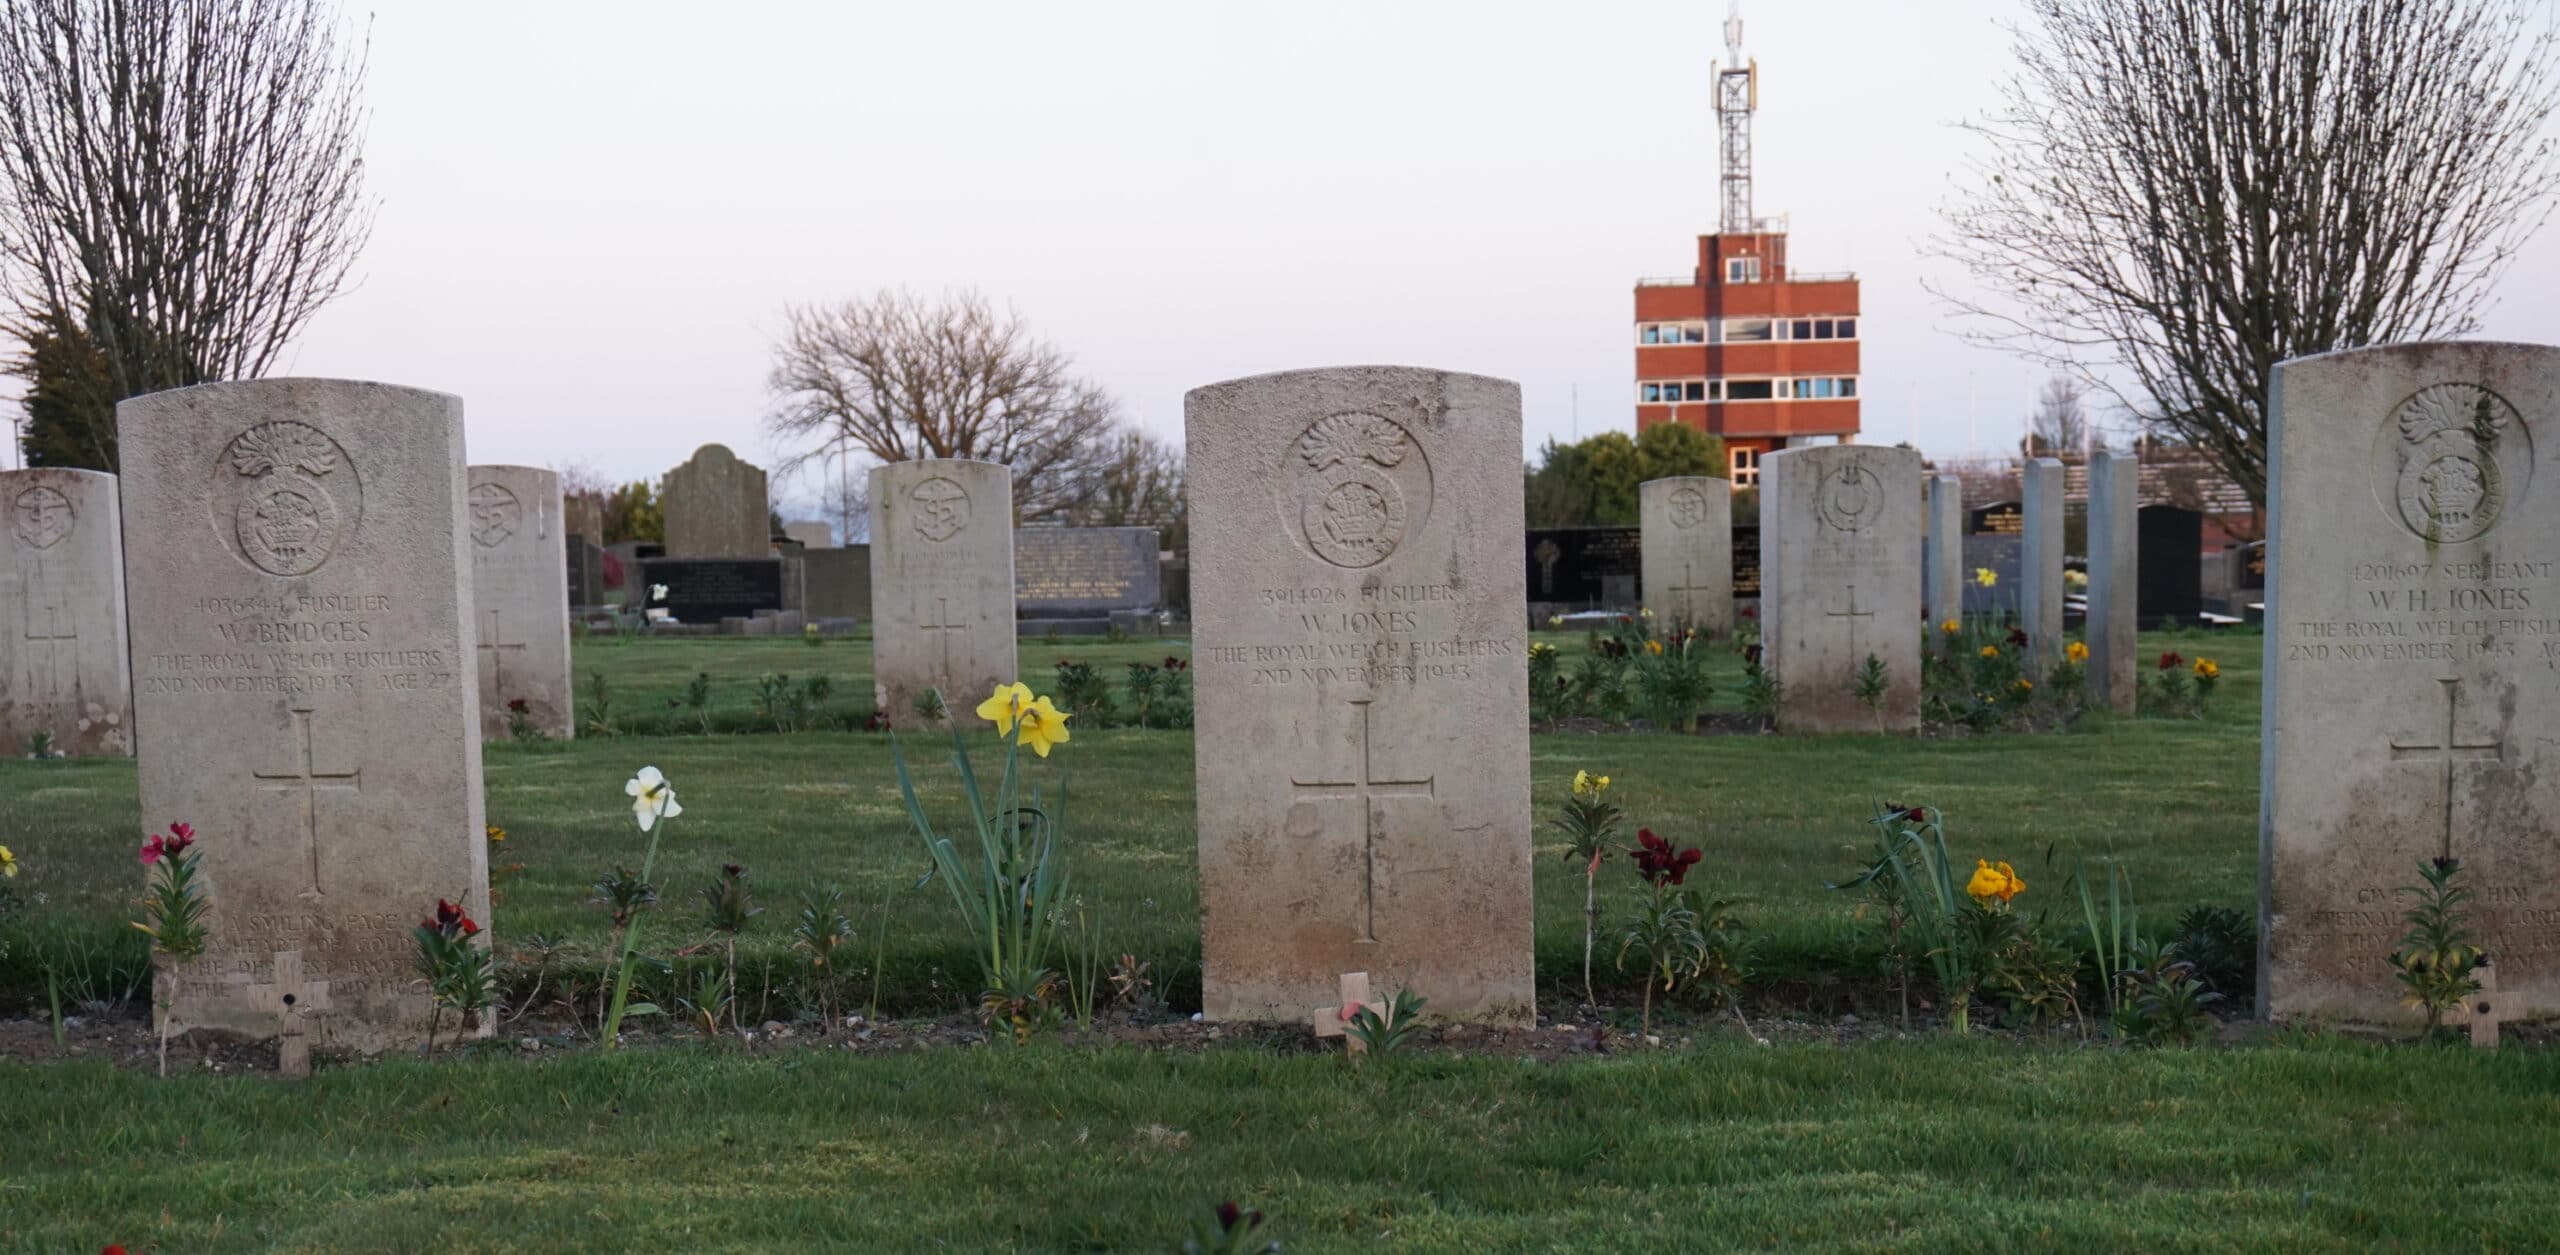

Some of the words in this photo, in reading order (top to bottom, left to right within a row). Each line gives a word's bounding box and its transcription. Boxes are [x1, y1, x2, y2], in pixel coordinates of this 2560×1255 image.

[297, 594, 391, 612] FUSILIER
[1261, 587, 1347, 606] 3914926
[1360, 584, 1456, 602] FUSILIER
[2446, 587, 2531, 612] JONES
[257, 621, 370, 643] BRIDGES
[1335, 610, 1417, 634] JONES
[2298, 621, 2338, 638] THE
[2345, 621, 2408, 638] ROYAL
[2417, 619, 2488, 637] WELCH
[2496, 618, 2560, 636] FUSILI
[152, 654, 192, 671] THE
[200, 652, 261, 671] ROYAL
[266, 651, 335, 670] WELCH
[343, 649, 441, 668] FUSILIERS
[1210, 645, 1248, 663] THE
[1255, 643, 1321, 662] ROYAL
[1328, 641, 1400, 660] WELCH
[1409, 638, 1513, 658] FUSILIERS
[2289, 643, 2329, 661] 2ND
[2338, 642, 2456, 661] NOVEMBER
[2538, 641, 2560, 658] AG
[143, 676, 184, 694] 2ND
[192, 675, 302, 693] NOVEMBER
[376, 672, 417, 690] AGE
[1251, 668, 1292, 686] 2ND
[1300, 664, 1417, 684] NOVEMBER
[1424, 662, 1472, 682] 1943
[248, 913, 335, 932] SMILING
[343, 911, 400, 931] FACE
[239, 959, 338, 976] DEEST
